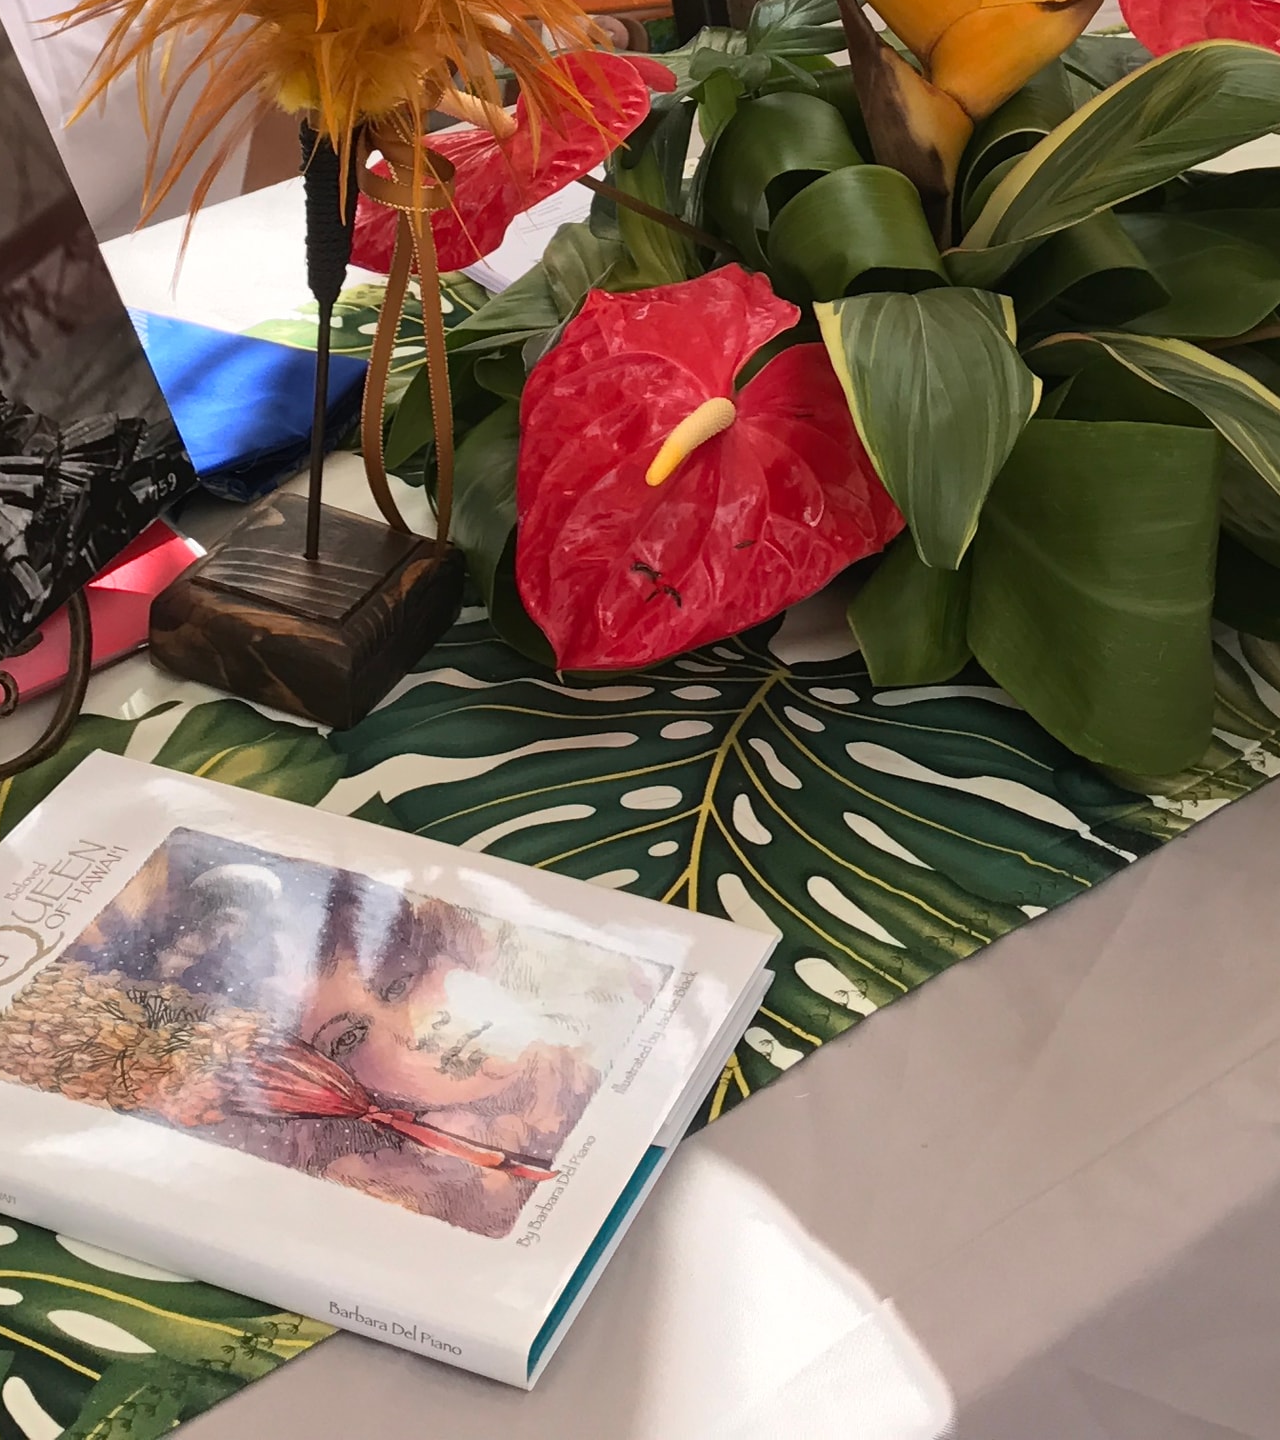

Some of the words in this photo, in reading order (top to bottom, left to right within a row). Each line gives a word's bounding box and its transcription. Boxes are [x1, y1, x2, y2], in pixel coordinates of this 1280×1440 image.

[3, 861, 47, 901] Beloved
[44, 895, 77, 930] OF
[611, 1043, 652, 1094] Illustrated
[516, 1231, 540, 1247] By
[528, 1186, 564, 1230] Barbara
[556, 1164, 576, 1186] Del
[569, 1136, 596, 1165] Piano
[329, 1301, 388, 1331] Barbara
[392, 1322, 417, 1341] Del
[420, 1332, 462, 1356] Piano
